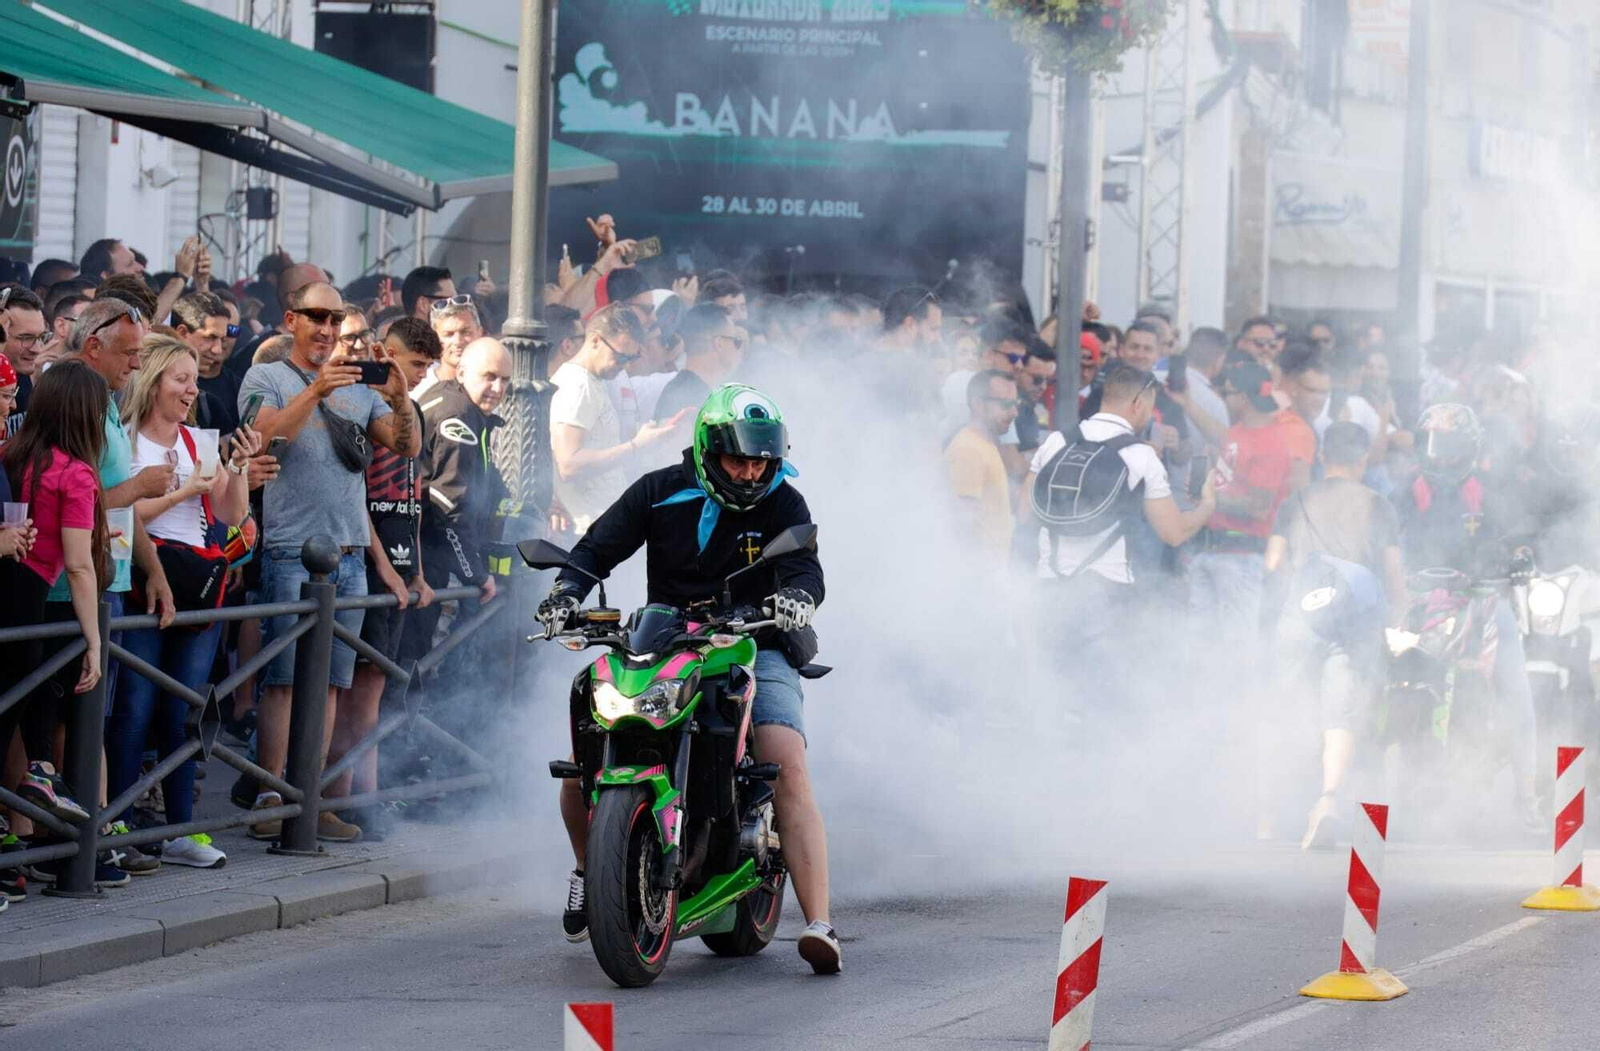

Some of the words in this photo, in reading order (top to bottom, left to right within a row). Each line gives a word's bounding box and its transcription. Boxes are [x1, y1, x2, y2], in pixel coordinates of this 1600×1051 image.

[705, 25, 796, 42] ESCENARIO
[799, 28, 882, 46] PRINCIPAL
[675, 92, 896, 140] BANANA
[702, 195, 724, 213] 28
[727, 197, 752, 214] AL
[755, 197, 777, 215] 30
[781, 198, 806, 215] DE
[809, 199, 864, 218] ABRIL
[370, 501, 396, 512] new
